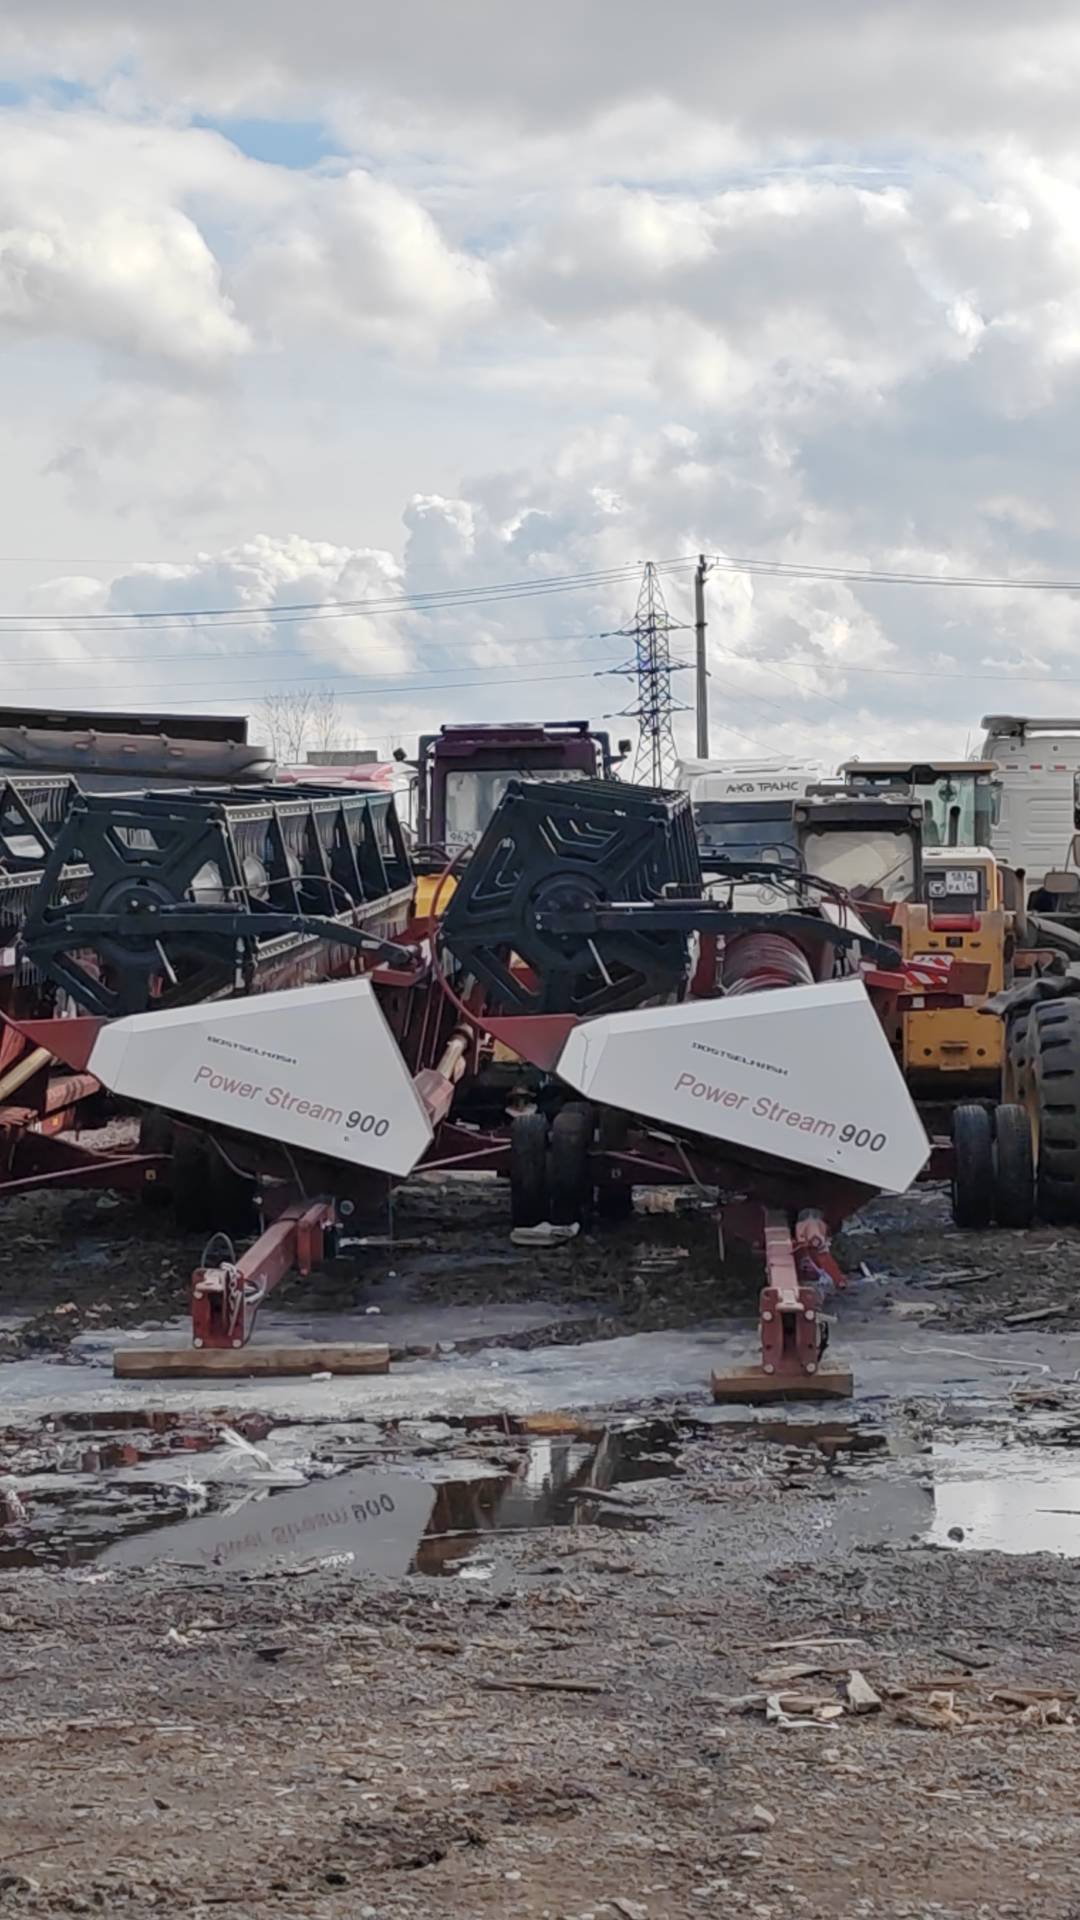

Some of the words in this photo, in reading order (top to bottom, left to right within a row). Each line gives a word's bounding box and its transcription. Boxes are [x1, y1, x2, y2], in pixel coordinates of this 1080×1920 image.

[193, 1066, 262, 1100] Power
[265, 1087, 343, 1125] Stream
[345, 1110, 389, 1137] 900
[674, 1072, 748, 1109] Power
[752, 1097, 836, 1138] Stream
[838, 1124, 887, 1151] 900
